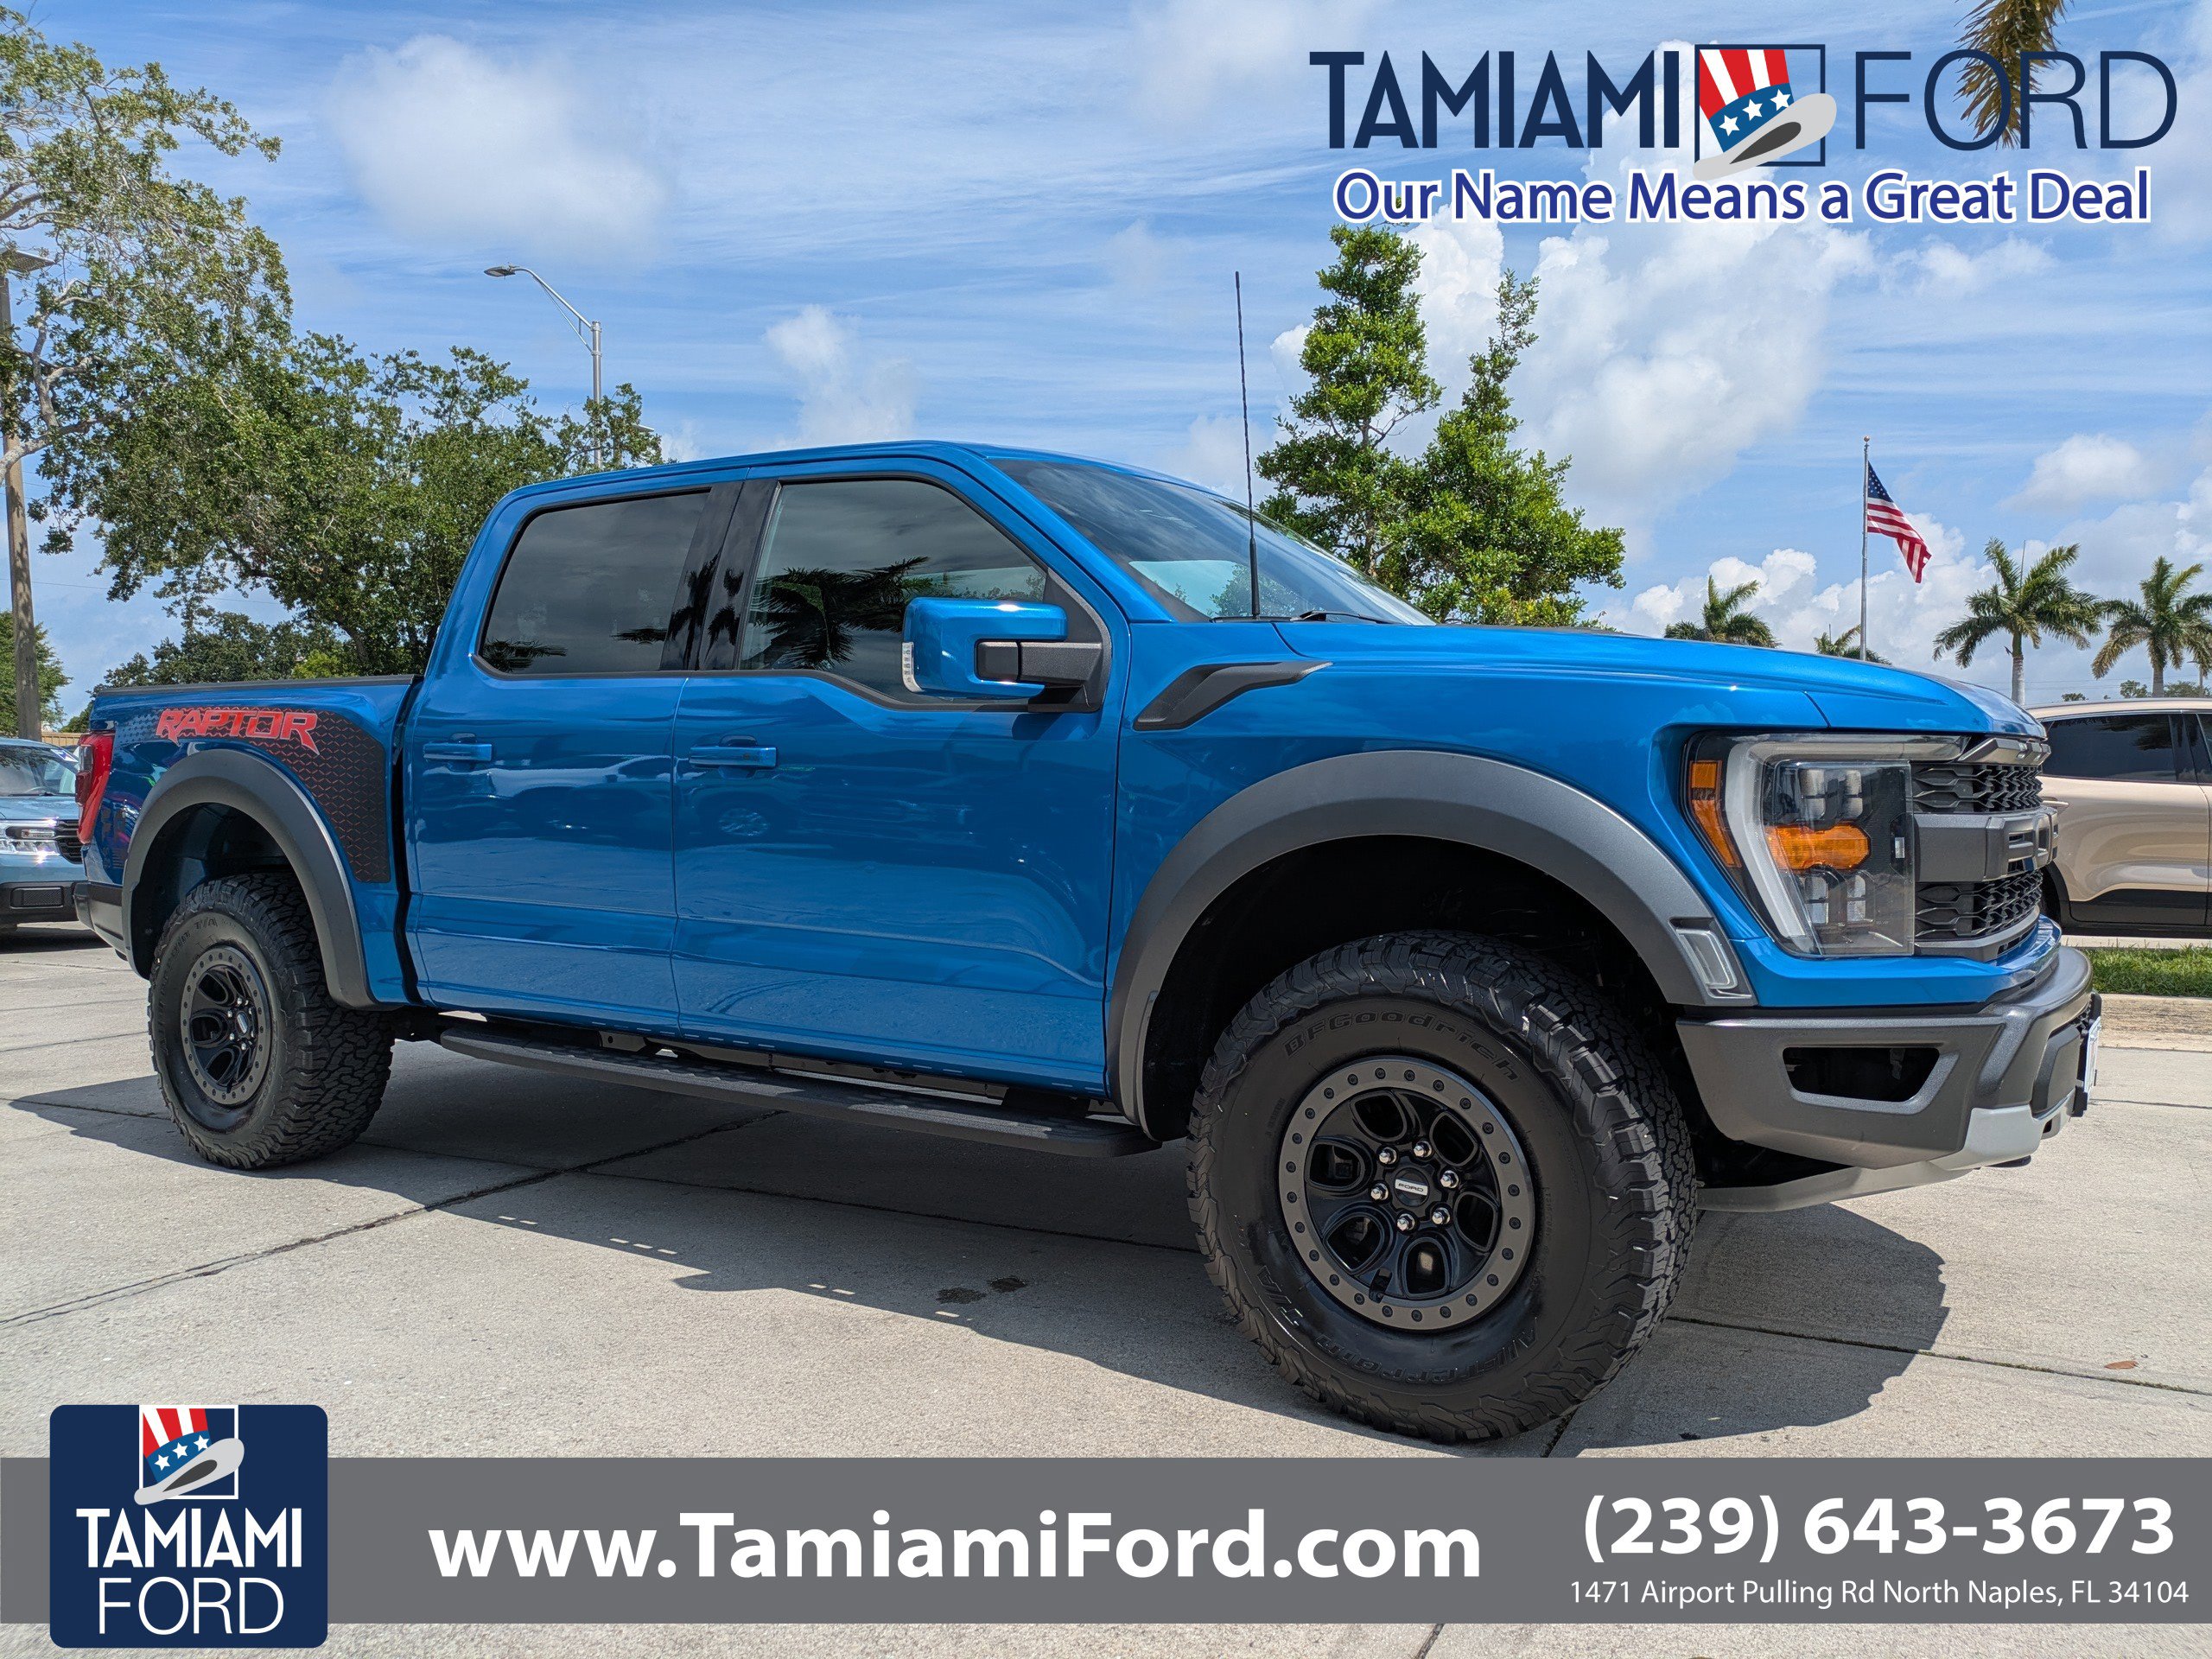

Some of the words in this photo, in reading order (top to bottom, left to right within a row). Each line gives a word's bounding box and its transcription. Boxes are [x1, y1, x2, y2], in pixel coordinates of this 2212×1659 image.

[156, 710, 320, 755] RAPTOR
[1283, 1011, 1520, 1081] BFGoodrich
[1398, 1182, 1424, 1192] FORD
